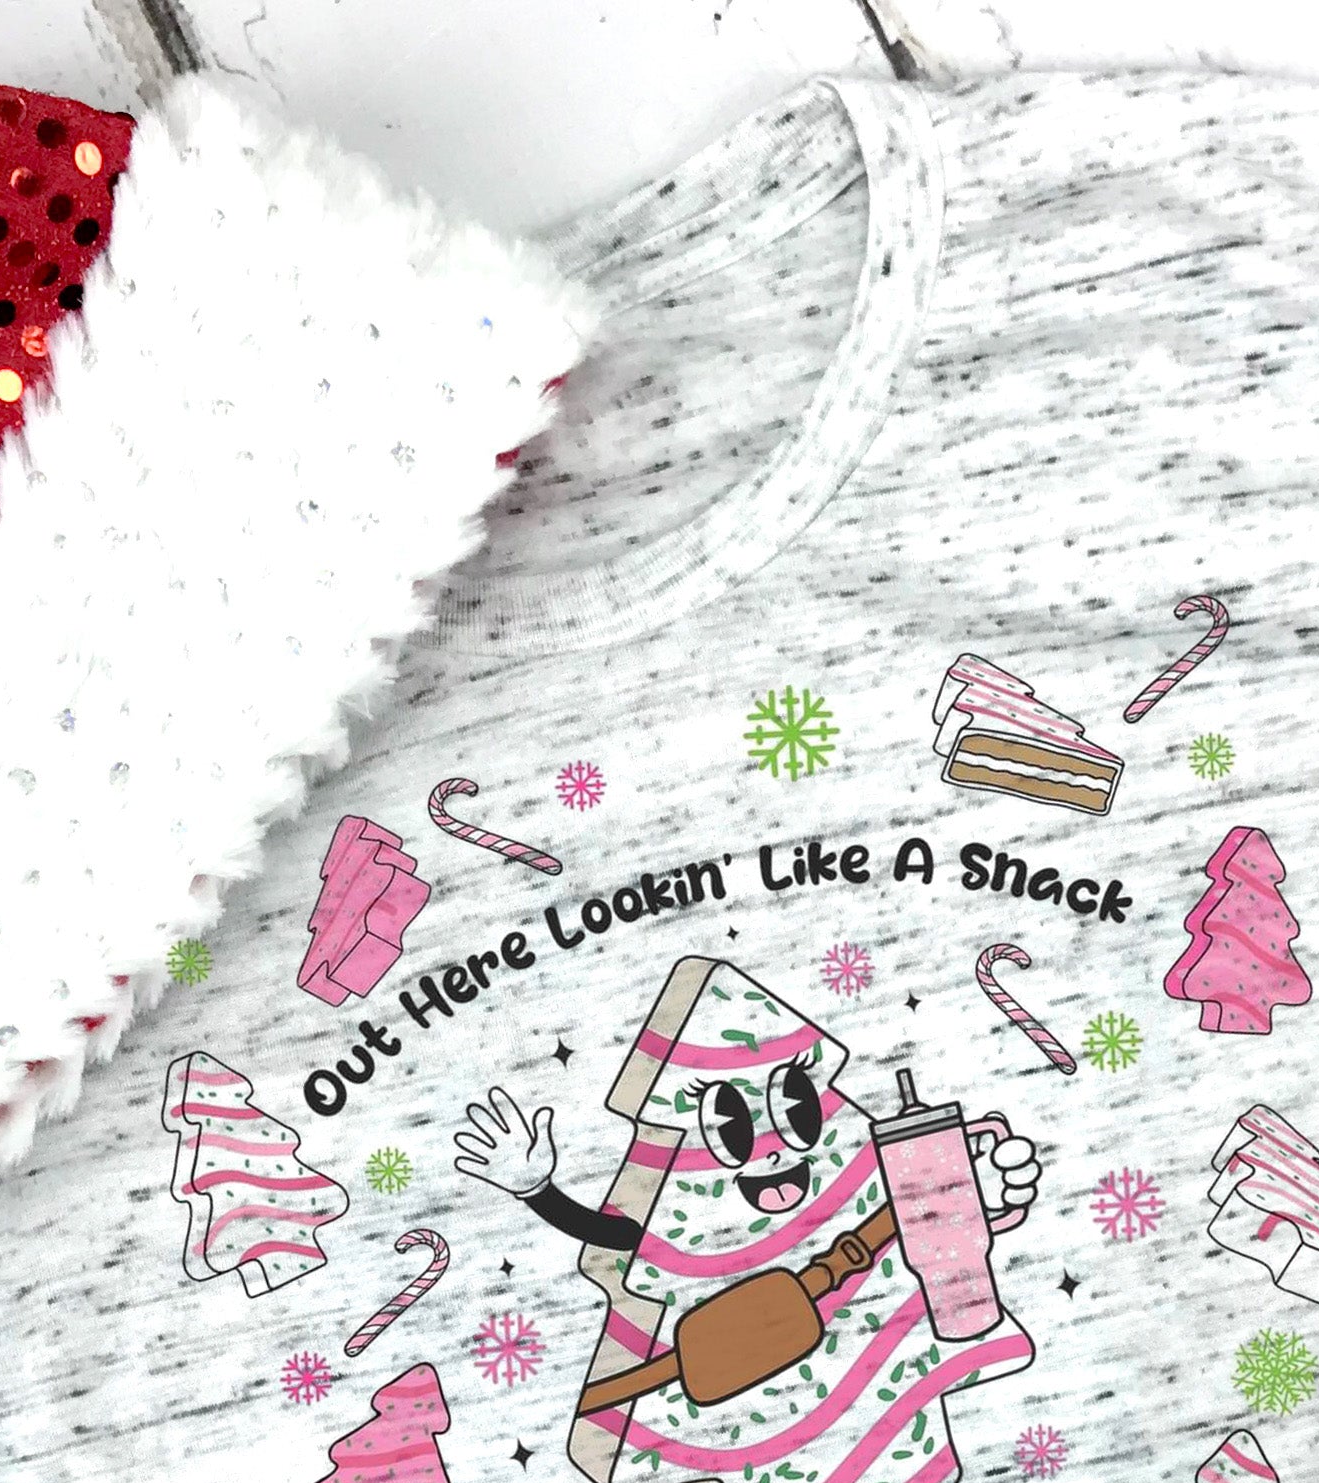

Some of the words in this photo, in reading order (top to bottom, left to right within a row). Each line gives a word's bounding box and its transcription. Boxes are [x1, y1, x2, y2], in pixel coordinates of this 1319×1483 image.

[303, 1020, 402, 1117] Out
[399, 931, 536, 1029] Here
[544, 853, 732, 950] Lookin'
[759, 841, 870, 891] Like
[893, 837, 934, 885] A
[960, 842, 1133, 924] Snack
